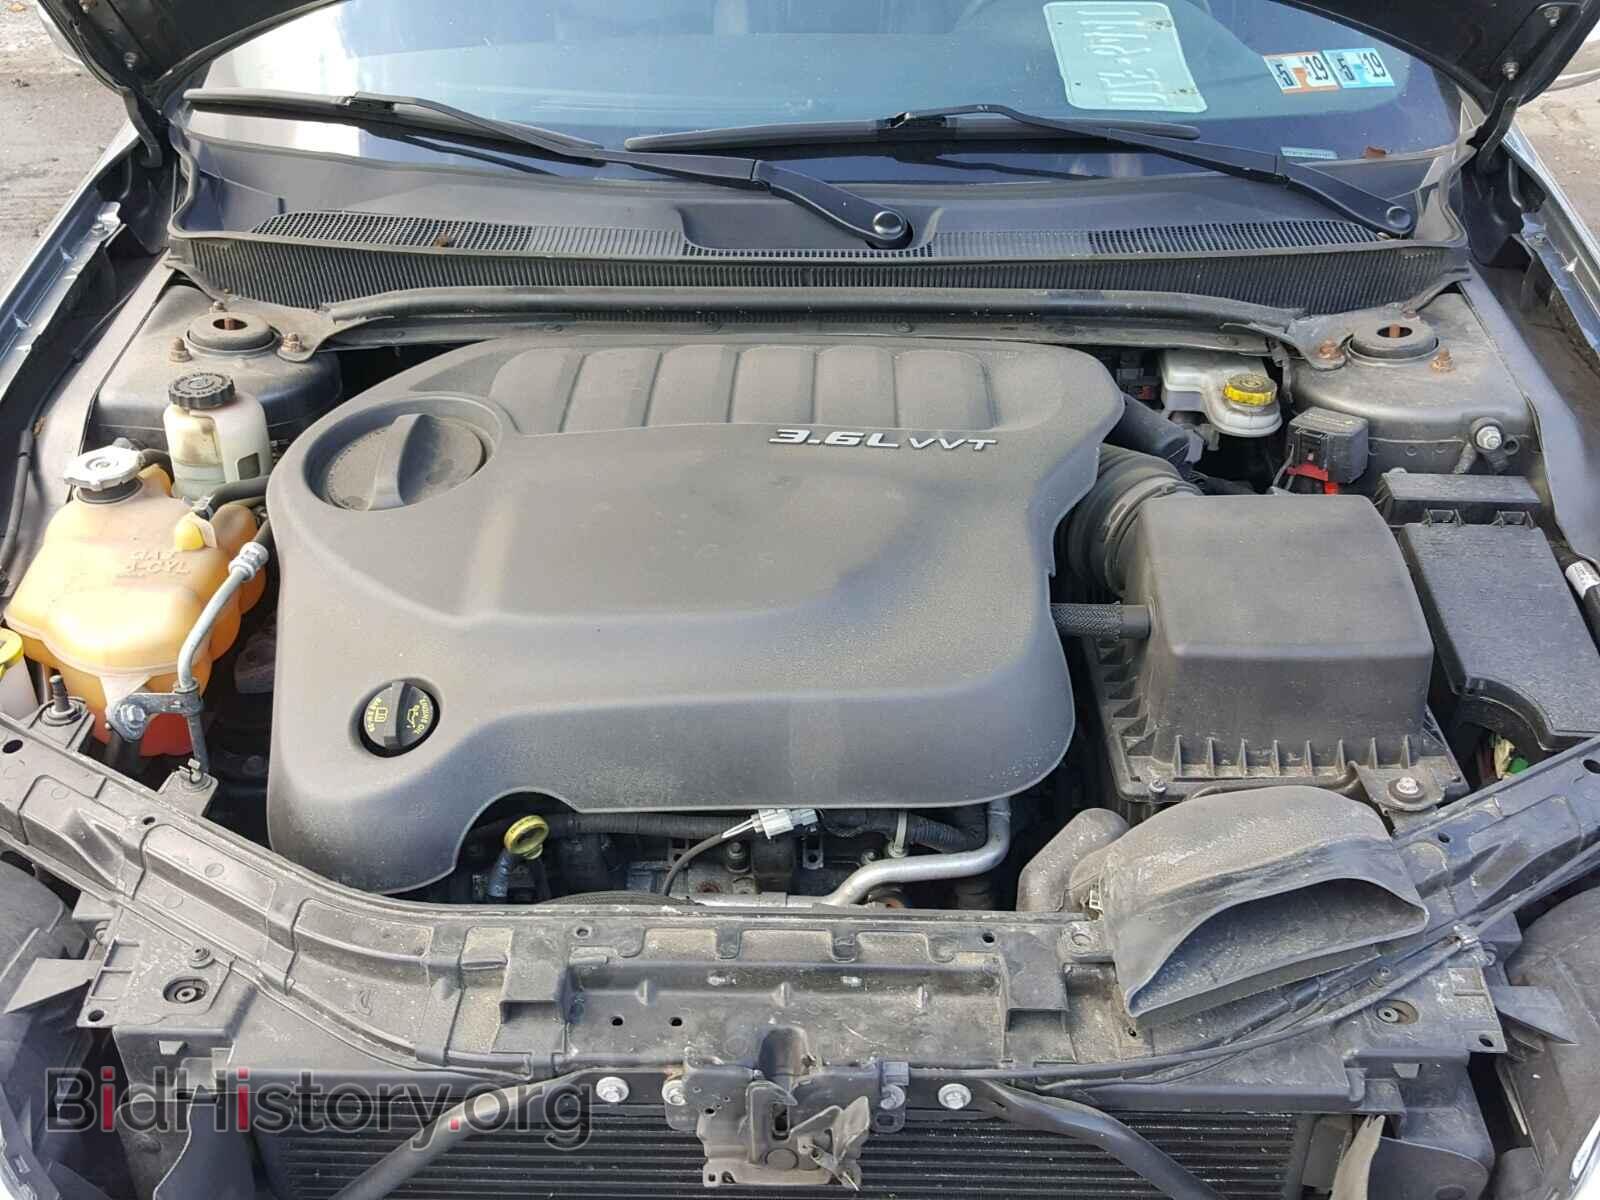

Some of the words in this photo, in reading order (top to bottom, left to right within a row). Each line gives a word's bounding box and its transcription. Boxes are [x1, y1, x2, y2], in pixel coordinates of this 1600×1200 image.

[1276, 64, 1295, 87] 5
[1337, 58, 1355, 81] 5
[769, 429, 899, 448] 3.6L
[909, 438, 997, 451] VVT
